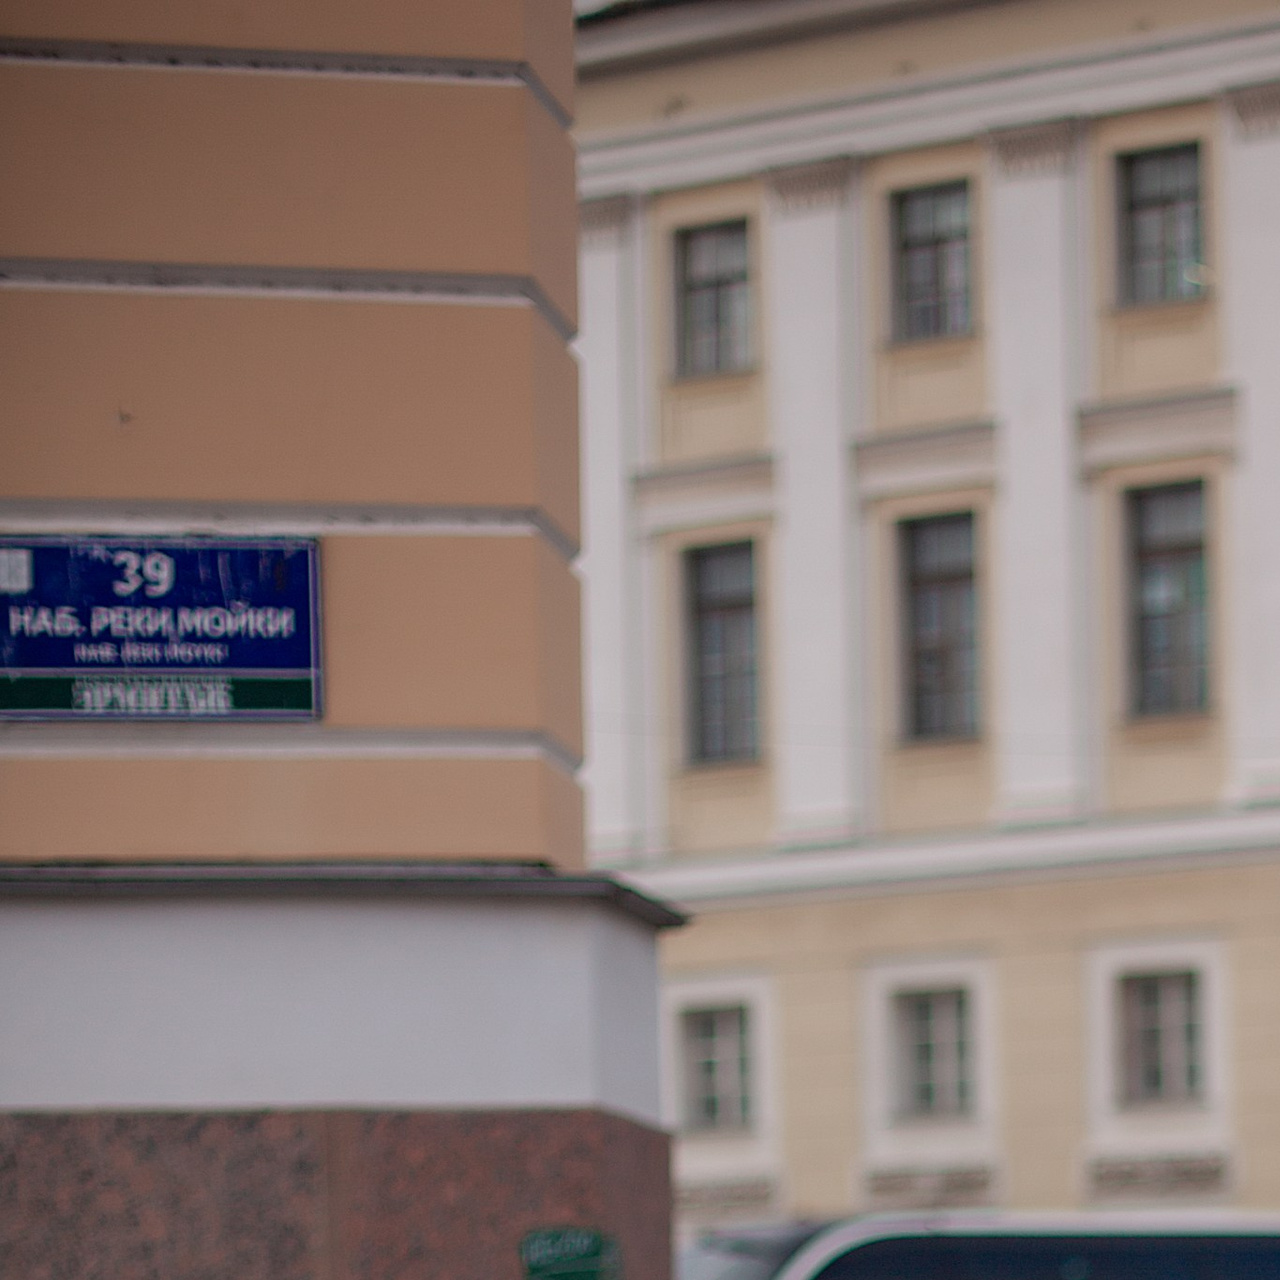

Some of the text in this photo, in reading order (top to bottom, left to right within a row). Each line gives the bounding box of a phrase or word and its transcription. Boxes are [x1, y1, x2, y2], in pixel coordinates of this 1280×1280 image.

[113, 552, 174, 597] 39
[9, 603, 296, 639] НАБ. РЕКИ МОЙКИ
